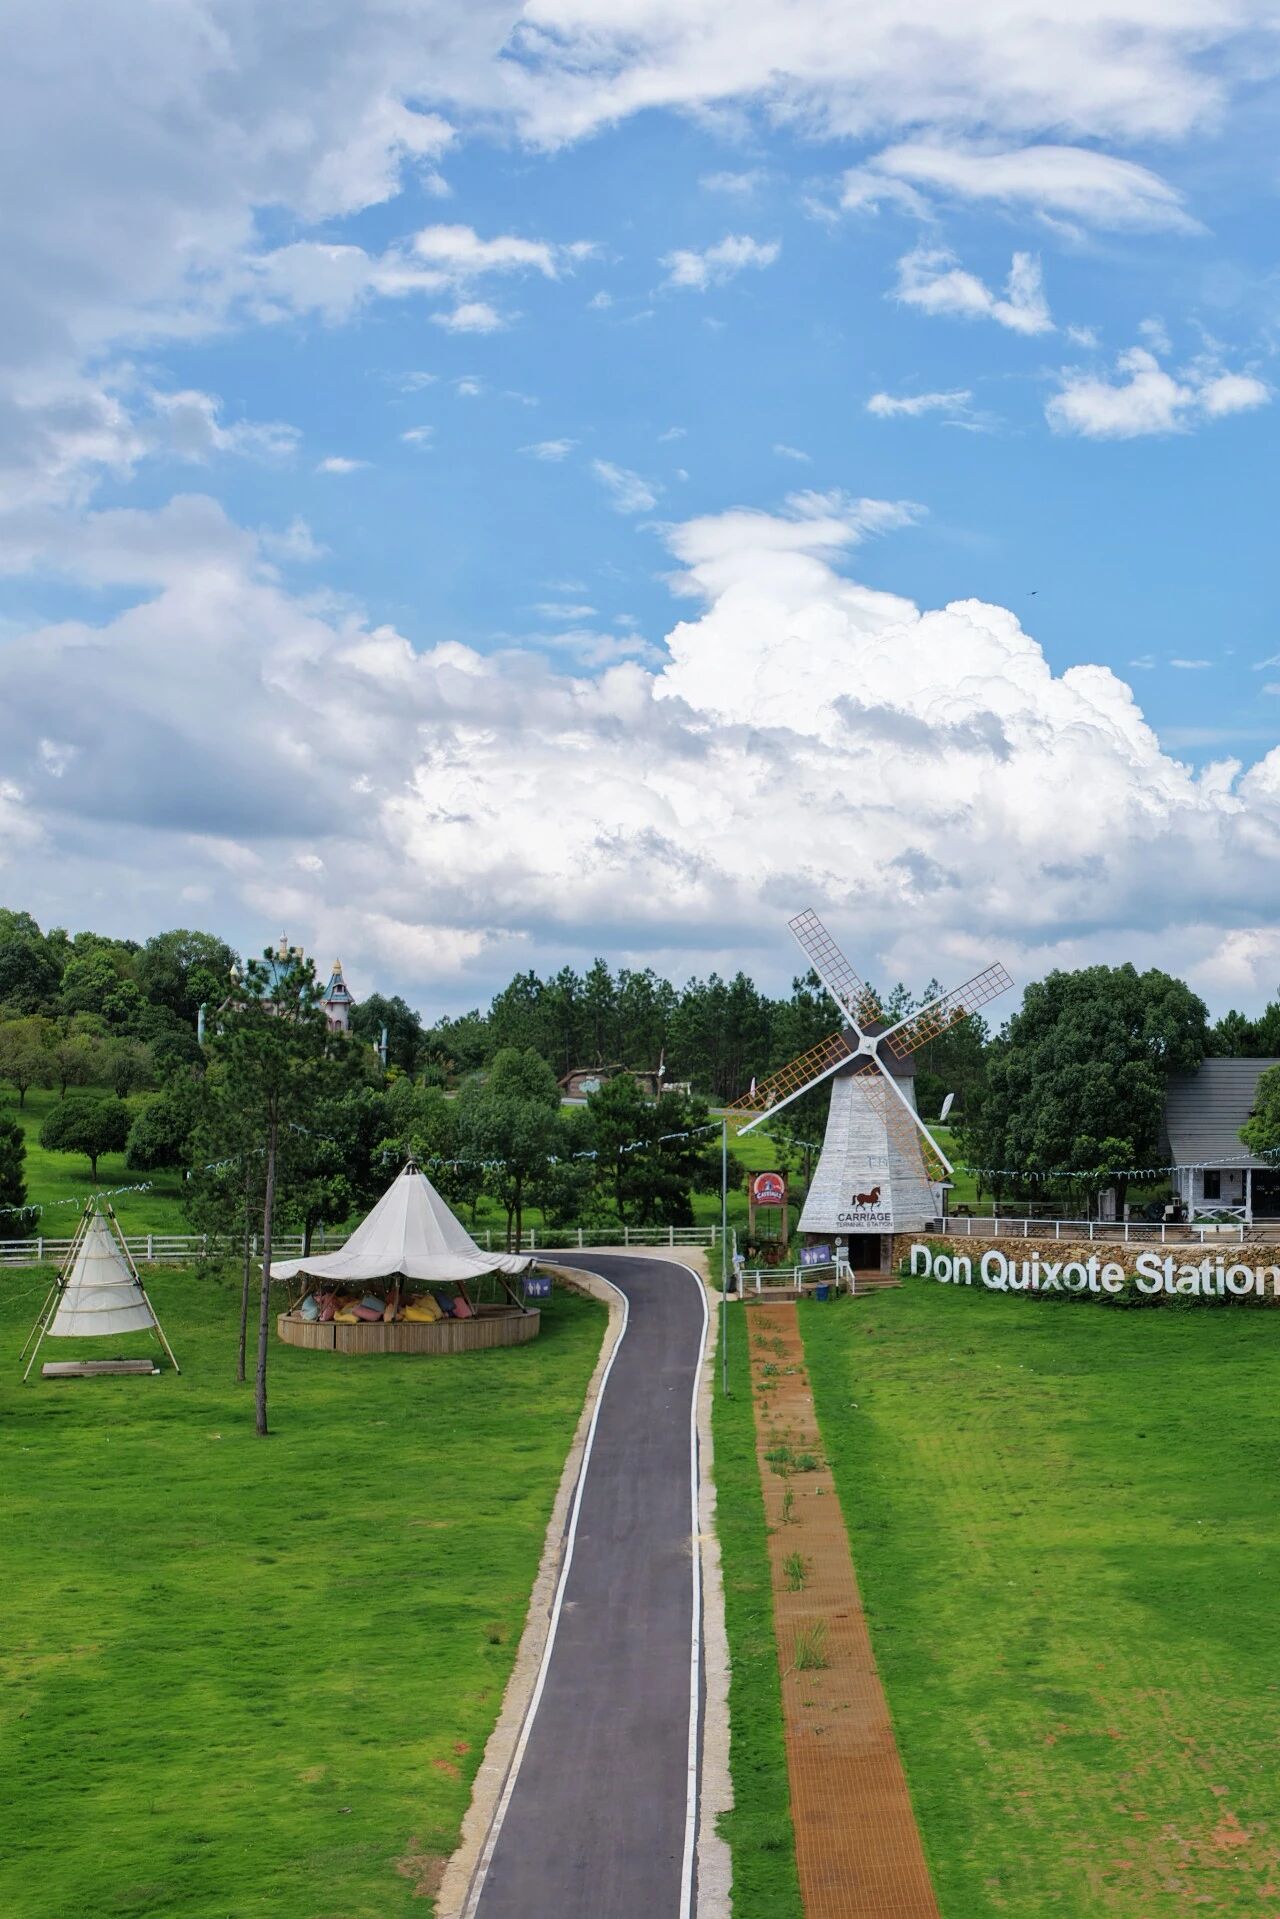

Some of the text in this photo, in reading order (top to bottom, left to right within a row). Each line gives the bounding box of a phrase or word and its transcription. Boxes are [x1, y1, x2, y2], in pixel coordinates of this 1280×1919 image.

[838, 1213, 891, 1221] CARRIAGE
[911, 1244, 1280, 1296] Don Quixote Station
